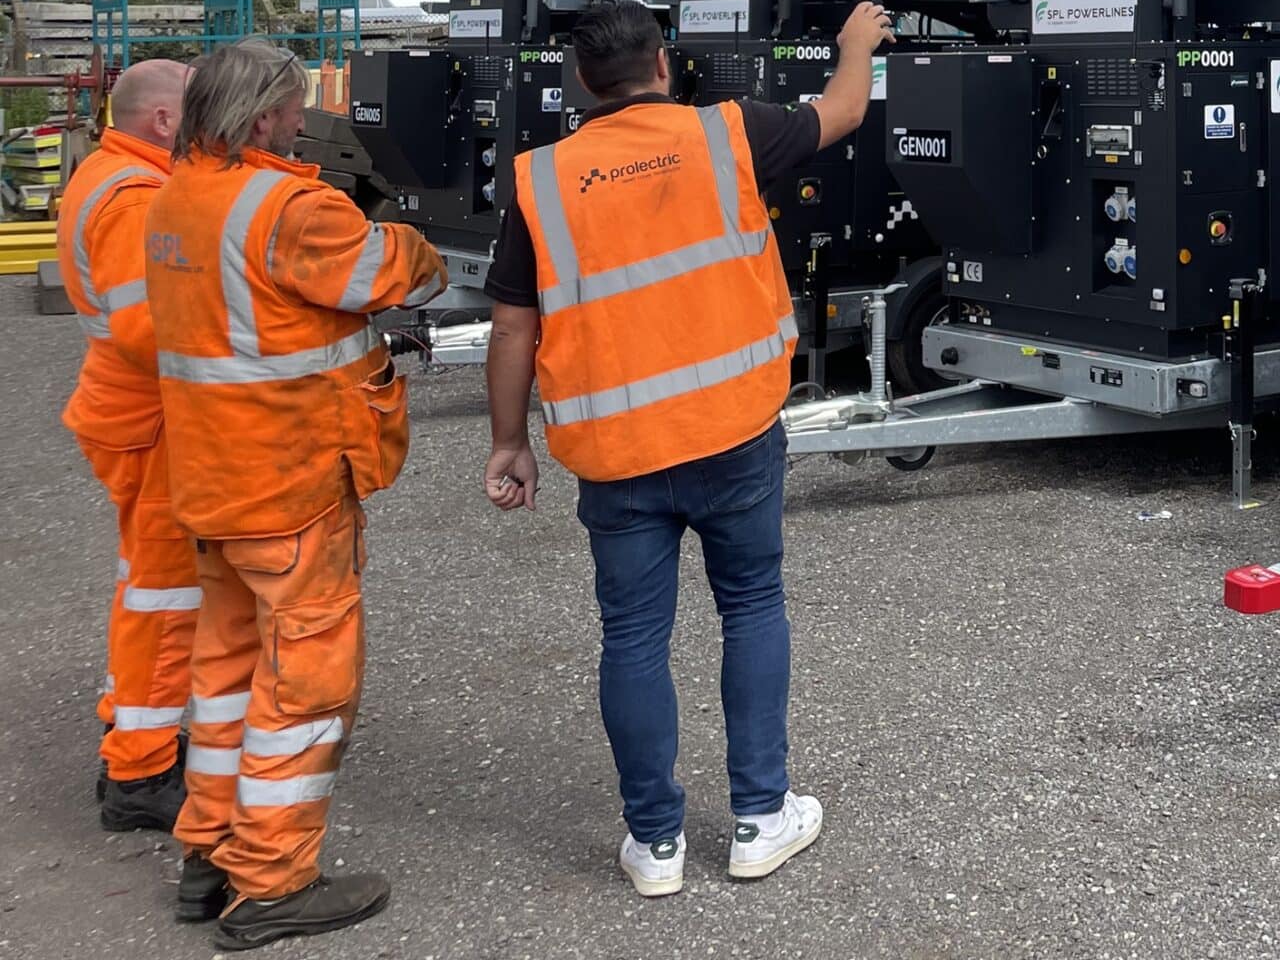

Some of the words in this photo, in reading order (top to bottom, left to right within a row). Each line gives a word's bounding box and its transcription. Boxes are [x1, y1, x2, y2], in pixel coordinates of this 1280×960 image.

[689, 12, 701, 21] SPL
[1047, 9, 1064, 20] SPL
[1067, 6, 1134, 19] POWERLINES
[520, 51, 564, 63] 1PP000
[773, 46, 831, 60] 1PP0006
[1176, 50, 1234, 67] 1PP0001
[355, 107, 381, 122] GEN005
[898, 136, 946, 158] GEN001
[610, 153, 681, 182] prolectric
[150, 232, 189, 264] SPL
